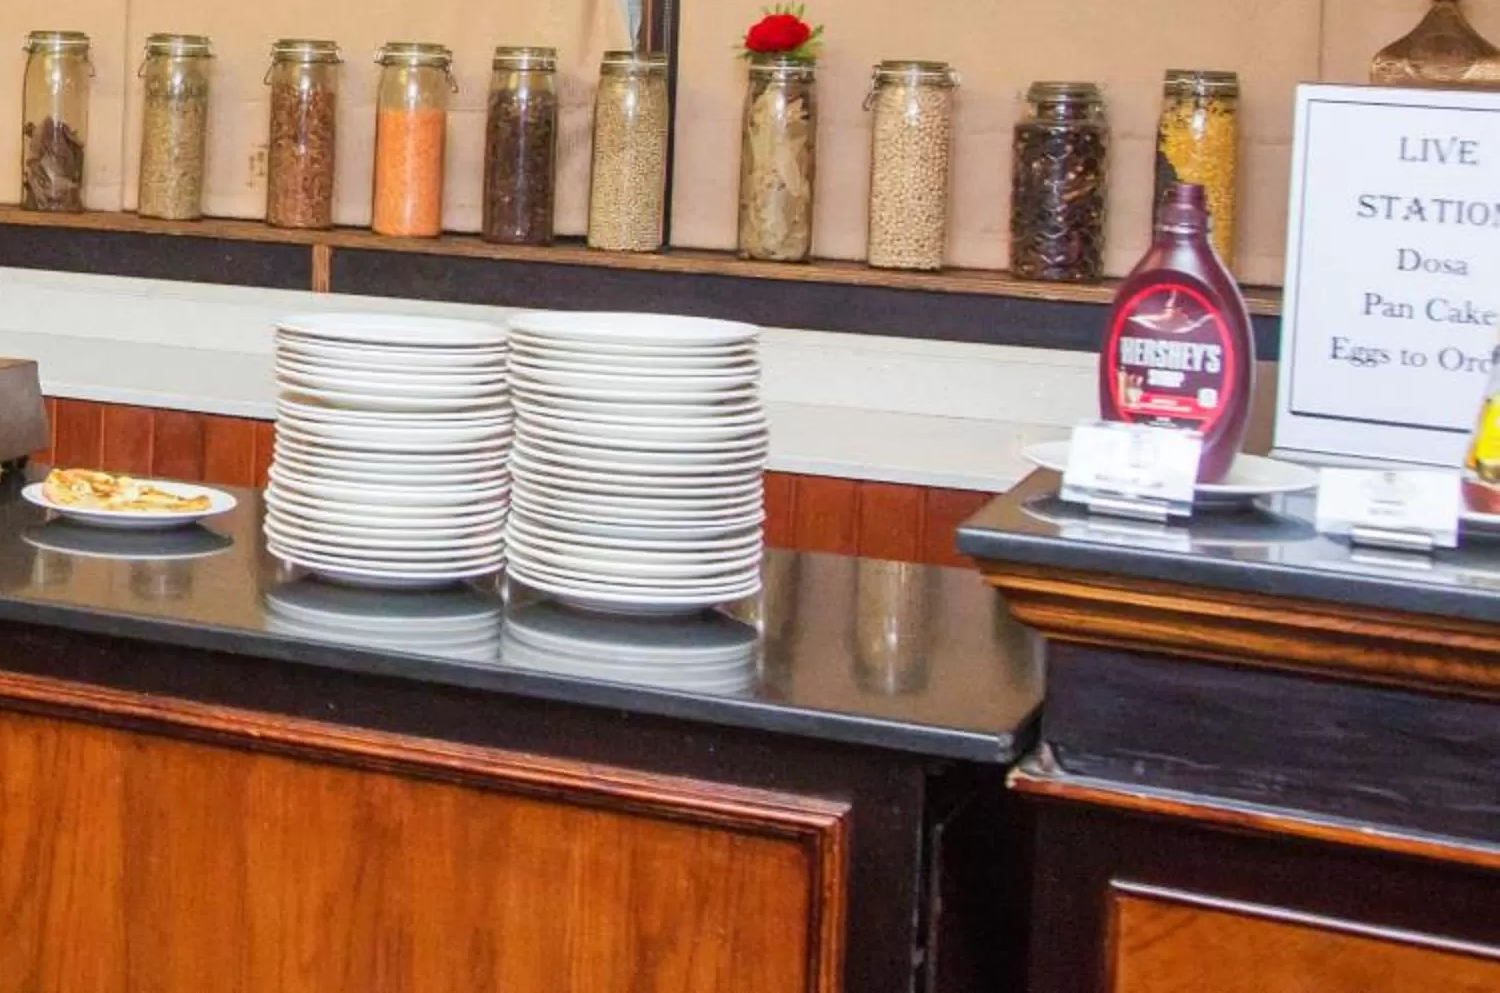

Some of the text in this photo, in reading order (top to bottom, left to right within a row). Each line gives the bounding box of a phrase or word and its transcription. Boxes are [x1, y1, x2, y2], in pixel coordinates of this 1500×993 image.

[1398, 136, 1479, 166] LIVE
[1396, 248, 1469, 276] Dosa
[1364, 292, 1414, 319] Pan
[1330, 335, 1392, 368] Eggs
[1400, 350, 1428, 368] to
